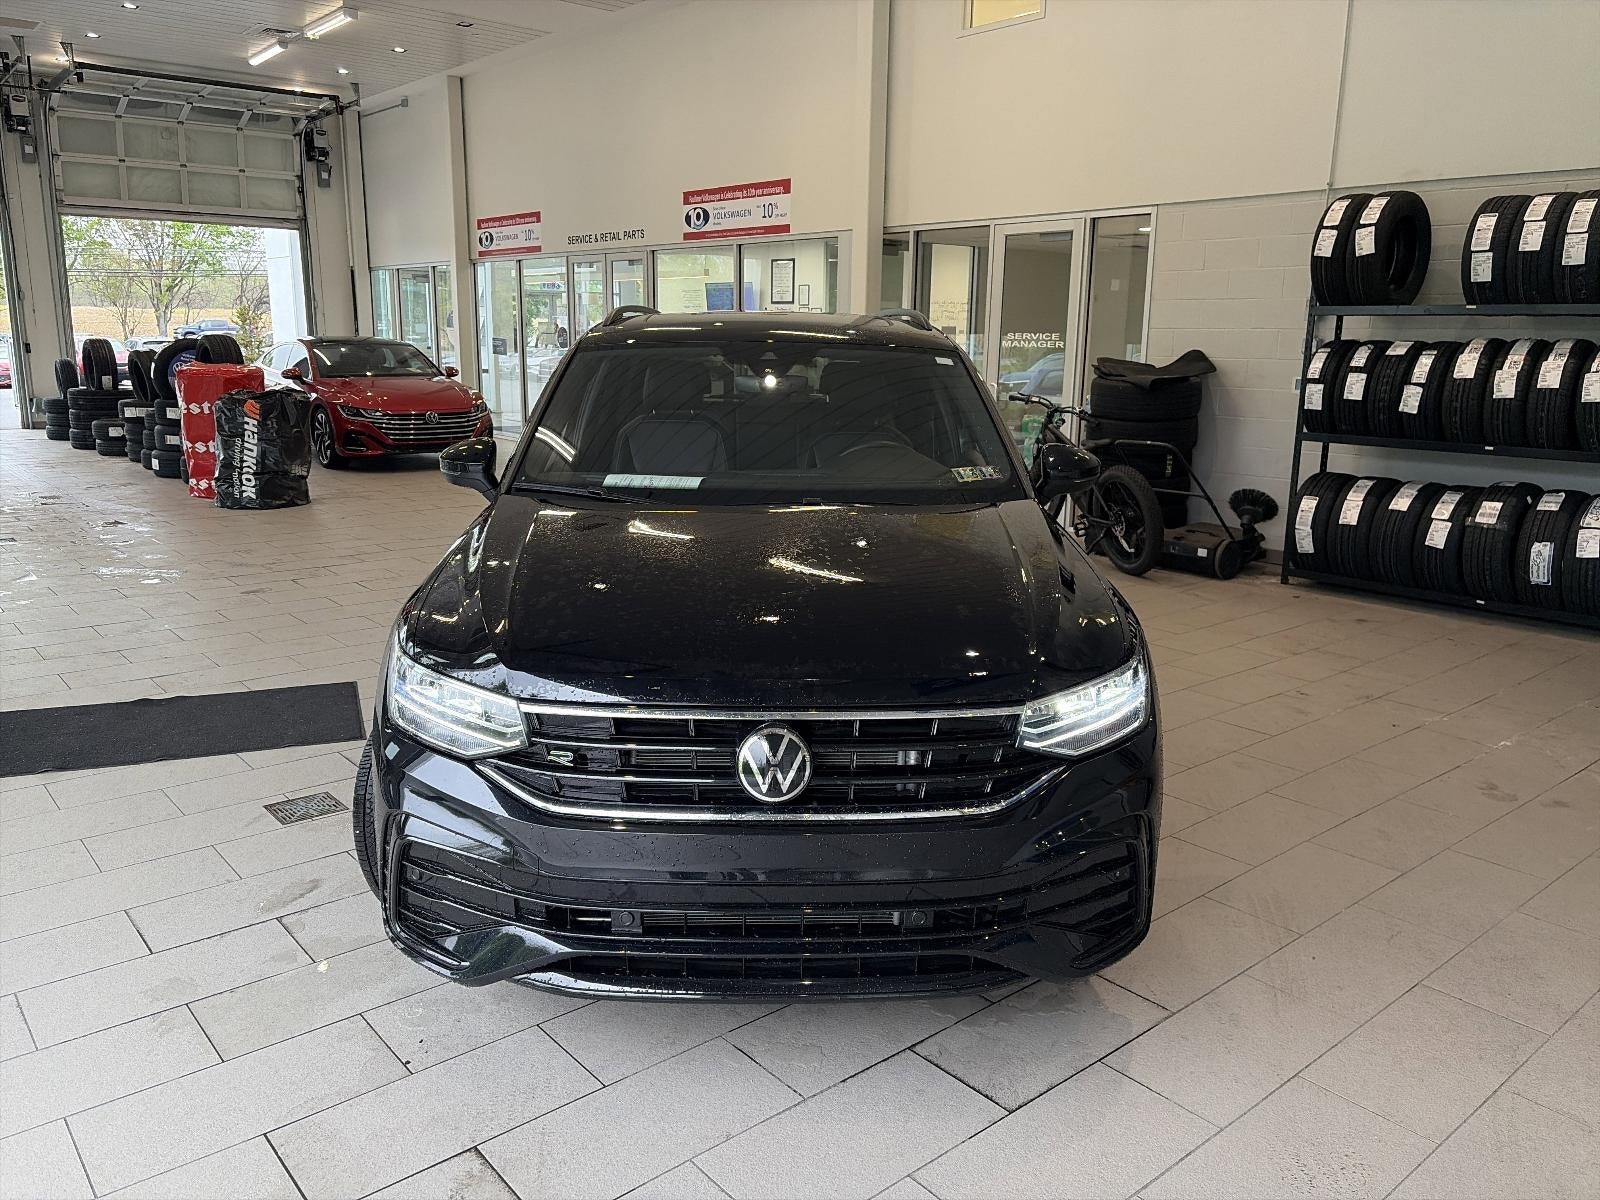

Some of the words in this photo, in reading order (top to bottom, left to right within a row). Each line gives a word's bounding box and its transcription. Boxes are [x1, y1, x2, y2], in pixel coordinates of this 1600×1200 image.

[713, 209, 752, 220] VOLKSWAGEN
[567, 234, 593, 245] SERVICE
[594, 233, 599, 243] &
[600, 231, 622, 242] RETAIL
[623, 228, 645, 240] PARTS
[1007, 332, 1061, 340] SERVICE
[1002, 340, 1065, 349] MANAGER
[232, 437, 241, 468] driving
